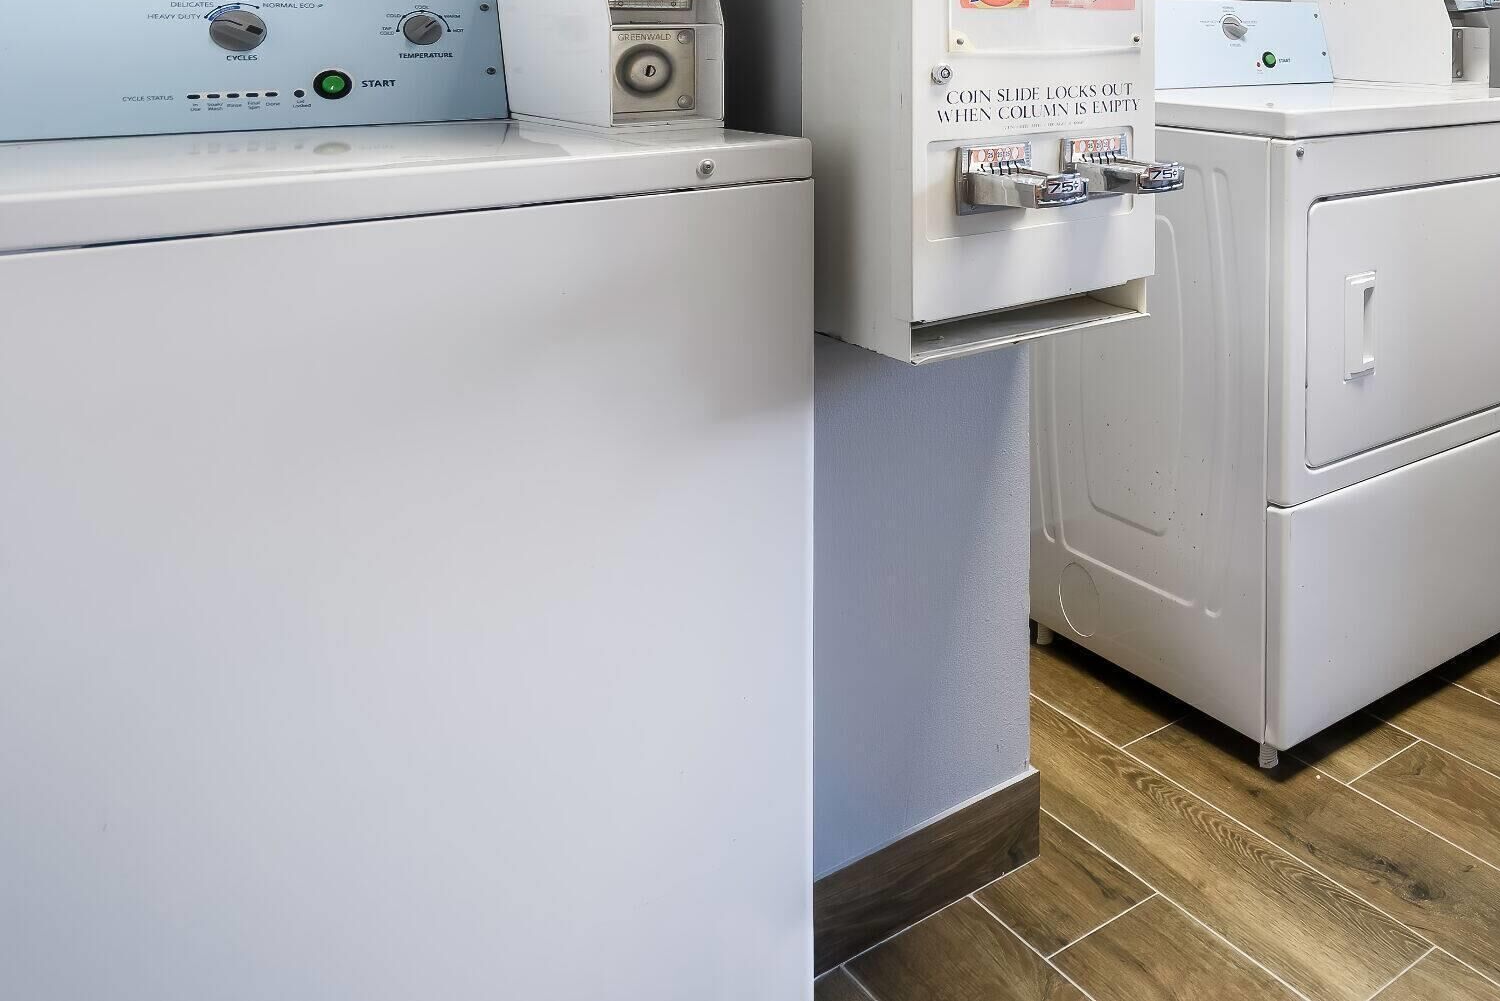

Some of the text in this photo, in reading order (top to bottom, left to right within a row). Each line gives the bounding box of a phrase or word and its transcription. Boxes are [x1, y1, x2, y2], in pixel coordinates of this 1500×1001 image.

[617, 33, 672, 41] GREENWALD
[361, 79, 396, 88] START
[946, 82, 1133, 105] COIN SLIDE LOCKS OUT
[937, 98, 1141, 124] WHEN COLUMN IS EMPTY
[1152, 167, 1178, 180] 75¢
[1048, 180, 1080, 194] 75¢
